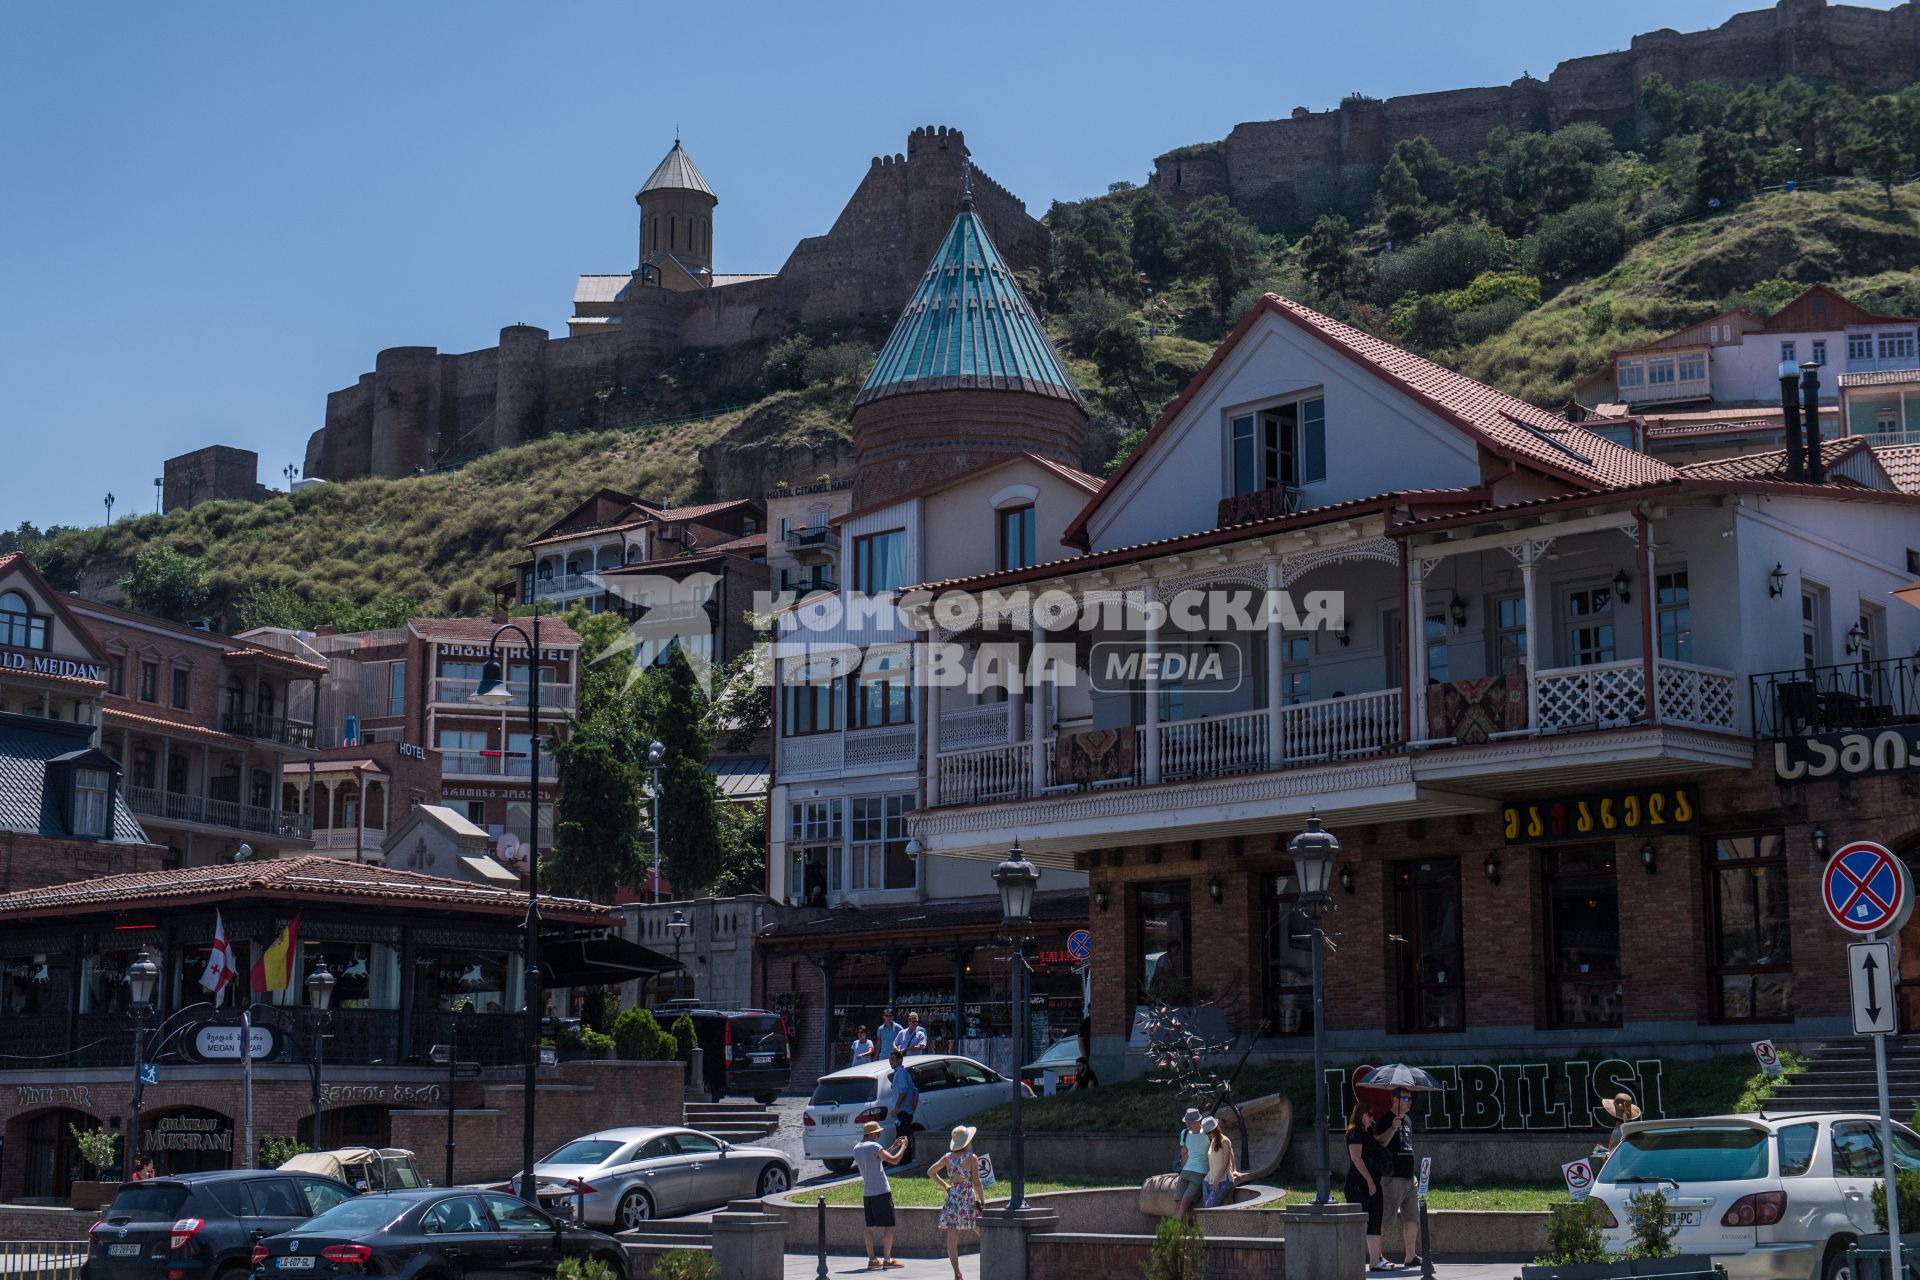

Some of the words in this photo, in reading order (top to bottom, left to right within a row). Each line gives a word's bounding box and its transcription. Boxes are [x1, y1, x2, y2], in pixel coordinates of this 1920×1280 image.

[766, 488, 794, 500] HOTEL
[795, 483, 829, 496] CITADEL
[33, 656, 101, 681] MEIDAN
[399, 742, 427, 760] HOTEL
[207, 1044, 235, 1052] MEIDAN
[58, 1085, 92, 1107] BAR
[1324, 1068, 1348, 1131] I
[1417, 1058, 1666, 1131] TBILISI
